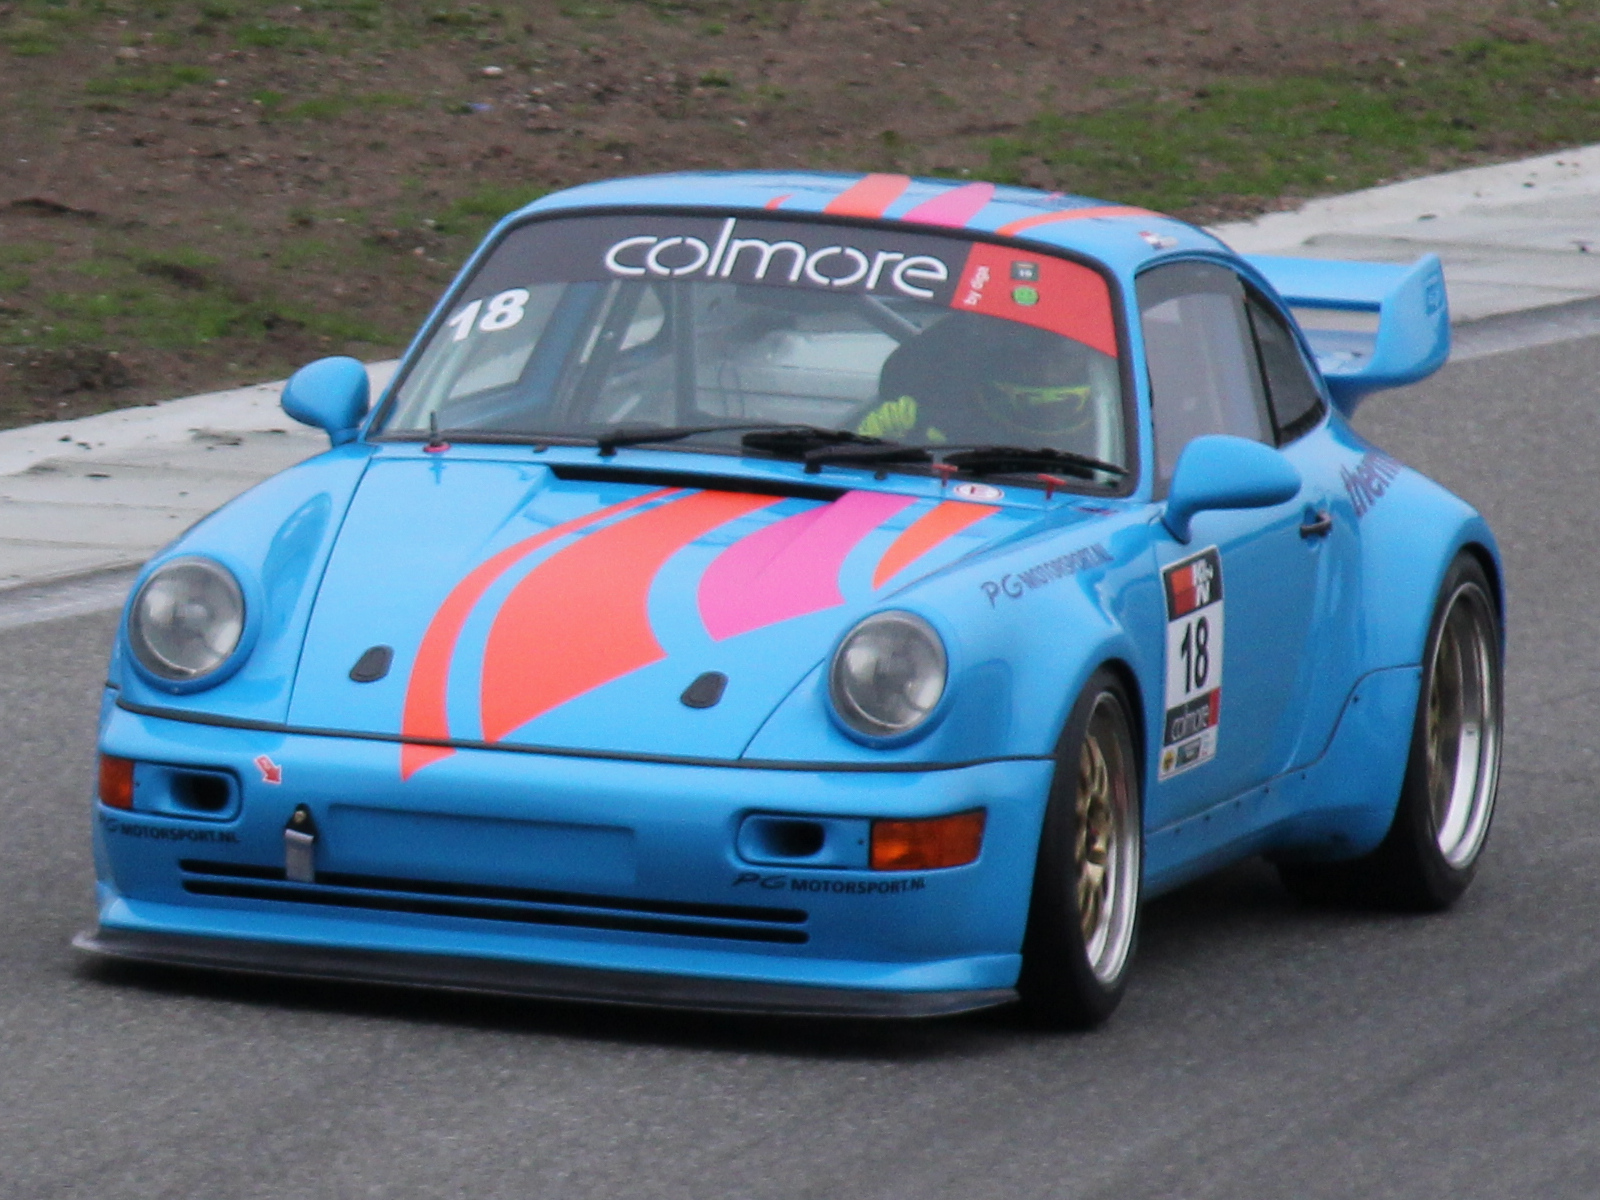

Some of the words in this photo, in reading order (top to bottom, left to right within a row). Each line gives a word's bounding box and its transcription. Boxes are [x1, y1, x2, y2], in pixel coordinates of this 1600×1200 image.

[605, 216, 948, 298] colmore
[447, 287, 530, 342] 18
[980, 573, 1024, 610] PG
[1181, 616, 1209, 694] 18
[731, 871, 789, 890] PG
[790, 876, 926, 895] MOTORSPORT.NL
